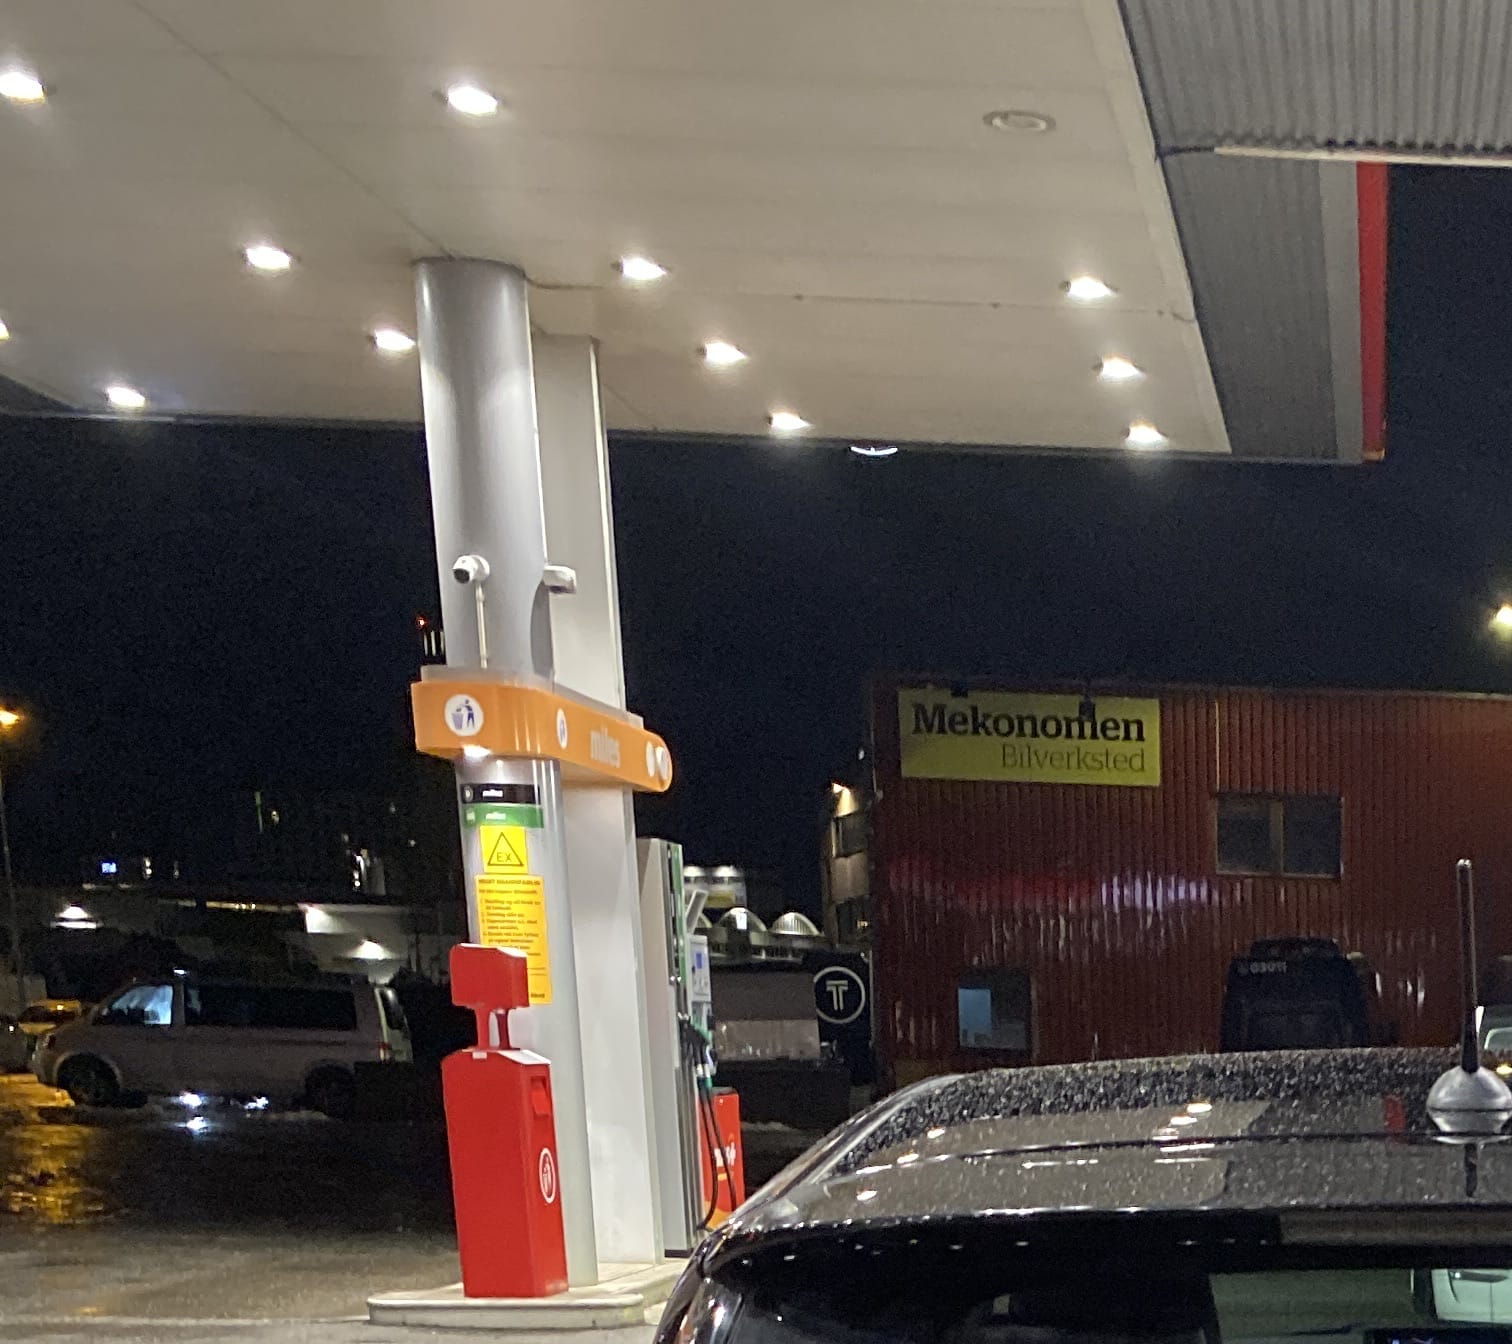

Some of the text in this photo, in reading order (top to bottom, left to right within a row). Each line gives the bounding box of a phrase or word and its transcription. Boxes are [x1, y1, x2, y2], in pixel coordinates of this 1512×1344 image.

[911, 702, 1146, 742] Mekonomen
[1001, 743, 1146, 773] Bilverksted
[497, 852, 511, 863] EX
